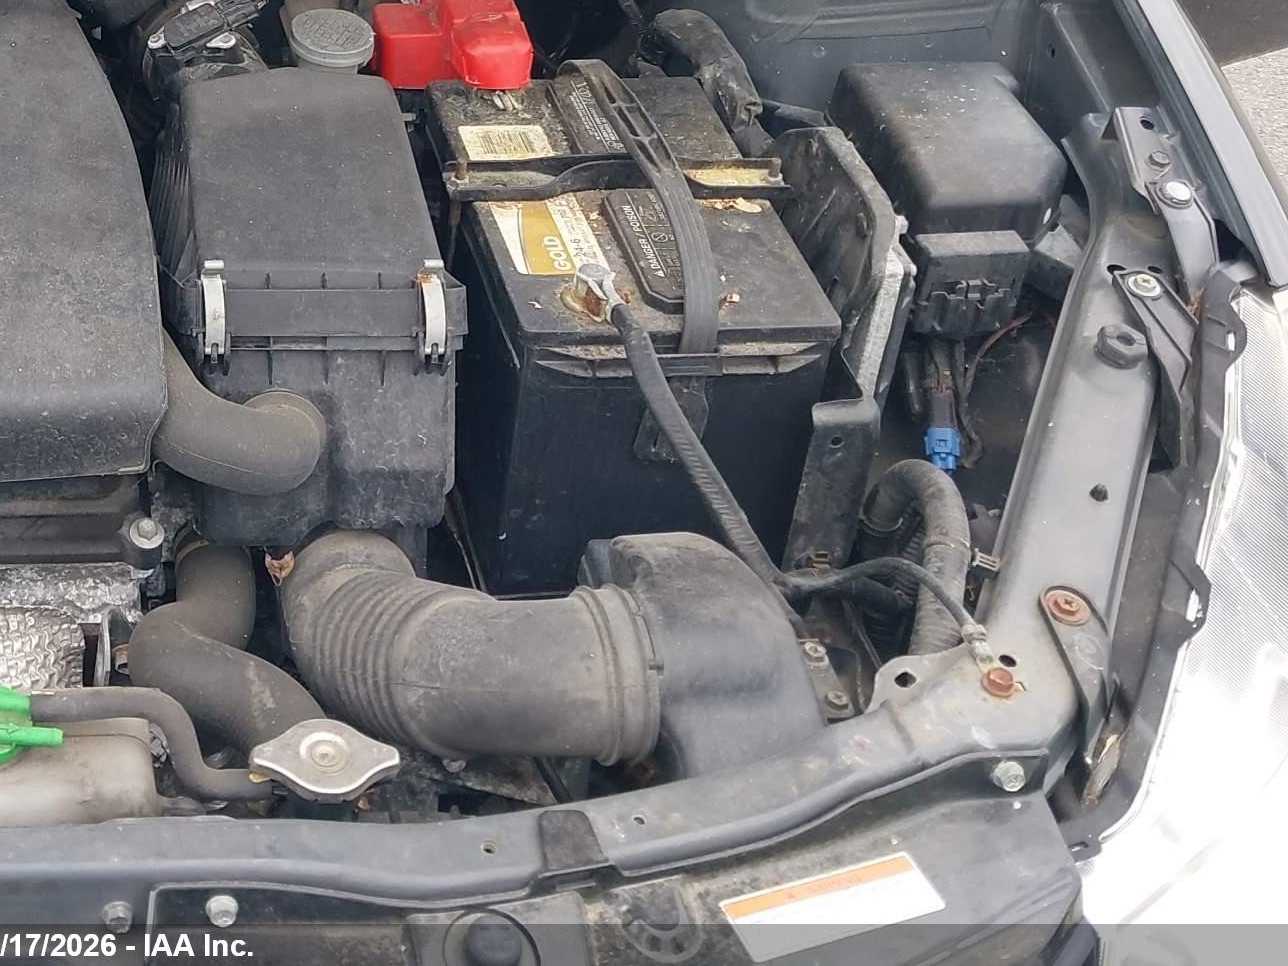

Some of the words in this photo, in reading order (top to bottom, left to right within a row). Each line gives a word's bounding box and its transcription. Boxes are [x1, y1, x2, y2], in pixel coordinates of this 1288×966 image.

[621, 205, 640, 232] POISON
[543, 235, 572, 271] GOLD
[640, 238, 661, 270] DANGER
